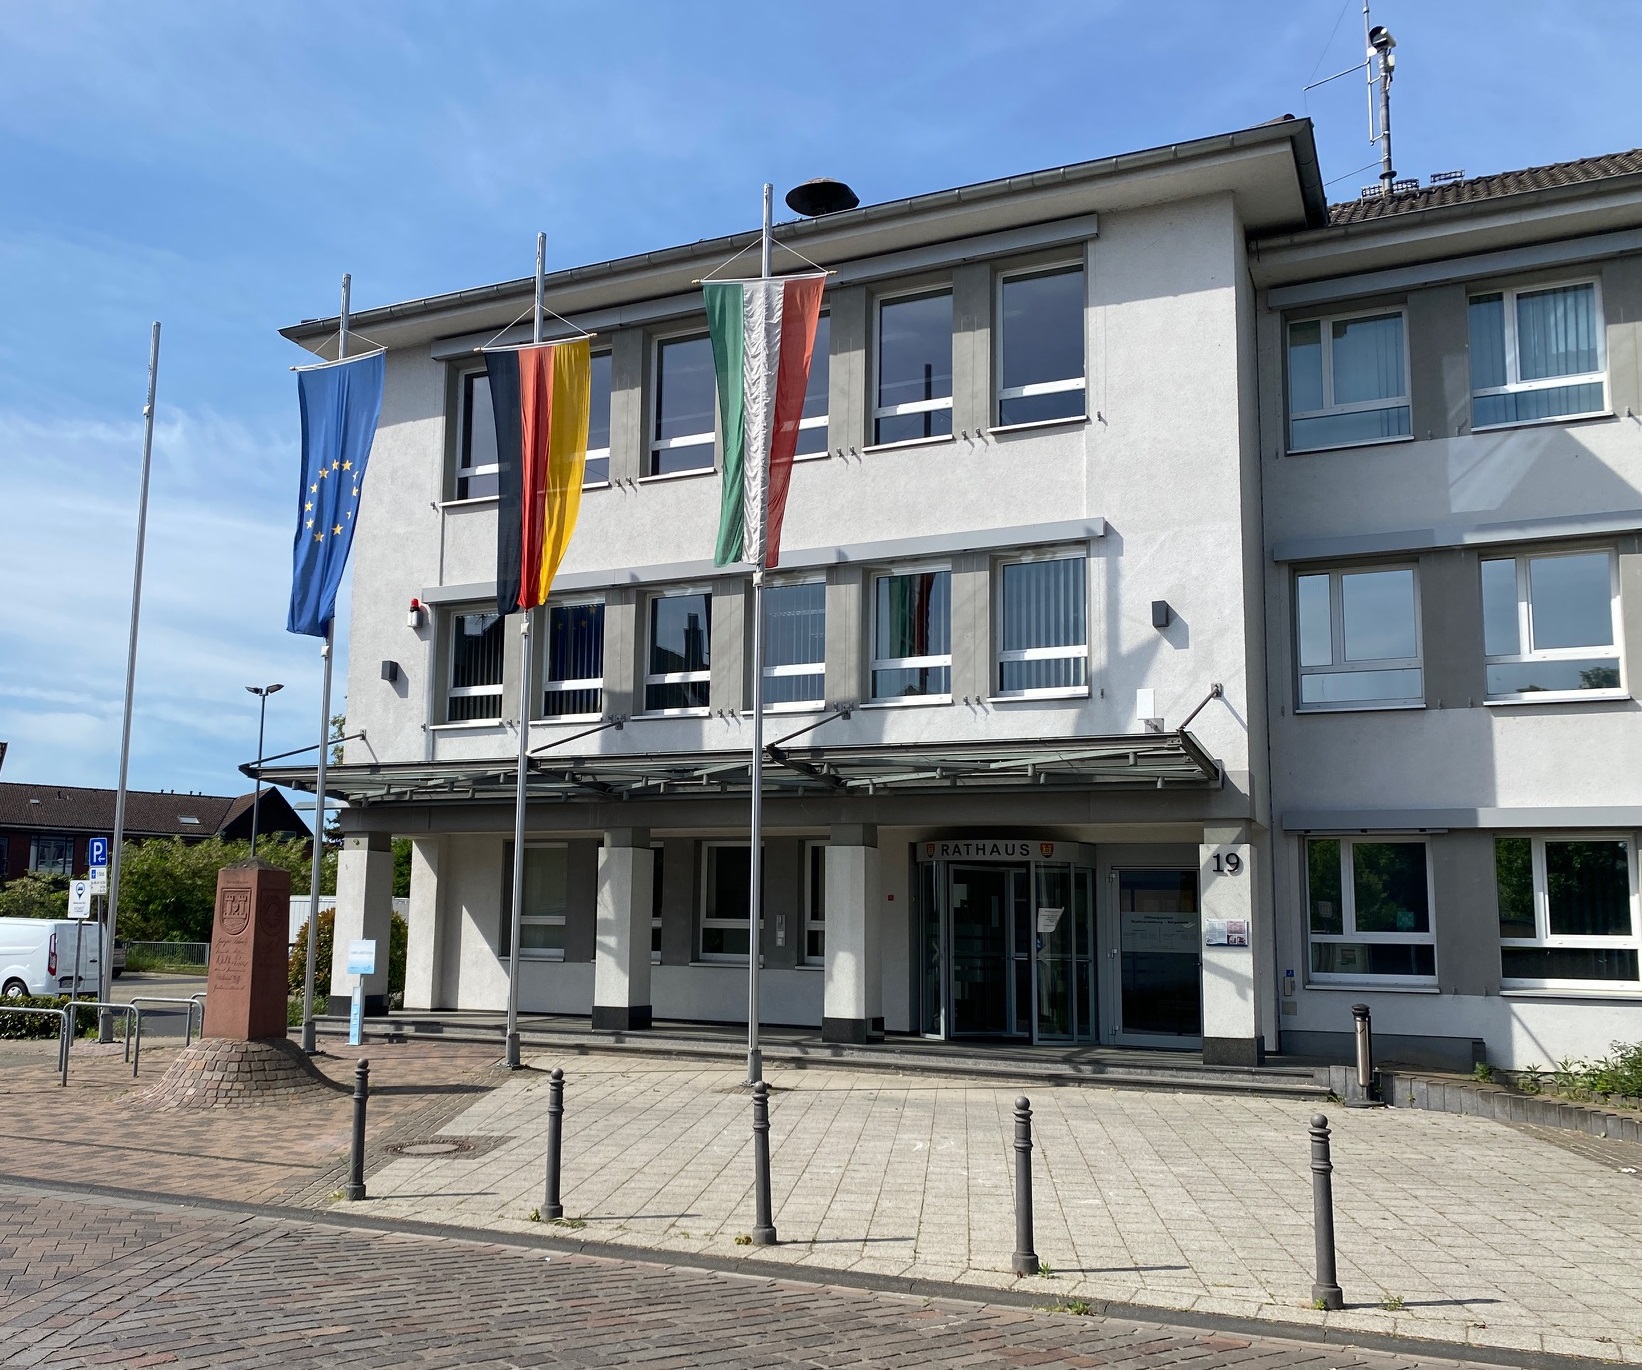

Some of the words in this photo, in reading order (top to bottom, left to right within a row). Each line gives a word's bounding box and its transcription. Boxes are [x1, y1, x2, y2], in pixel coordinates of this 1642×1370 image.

[93, 841, 103, 863] P
[941, 843, 1030, 856] RATHAUS
[1212, 852, 1240, 873] 19
